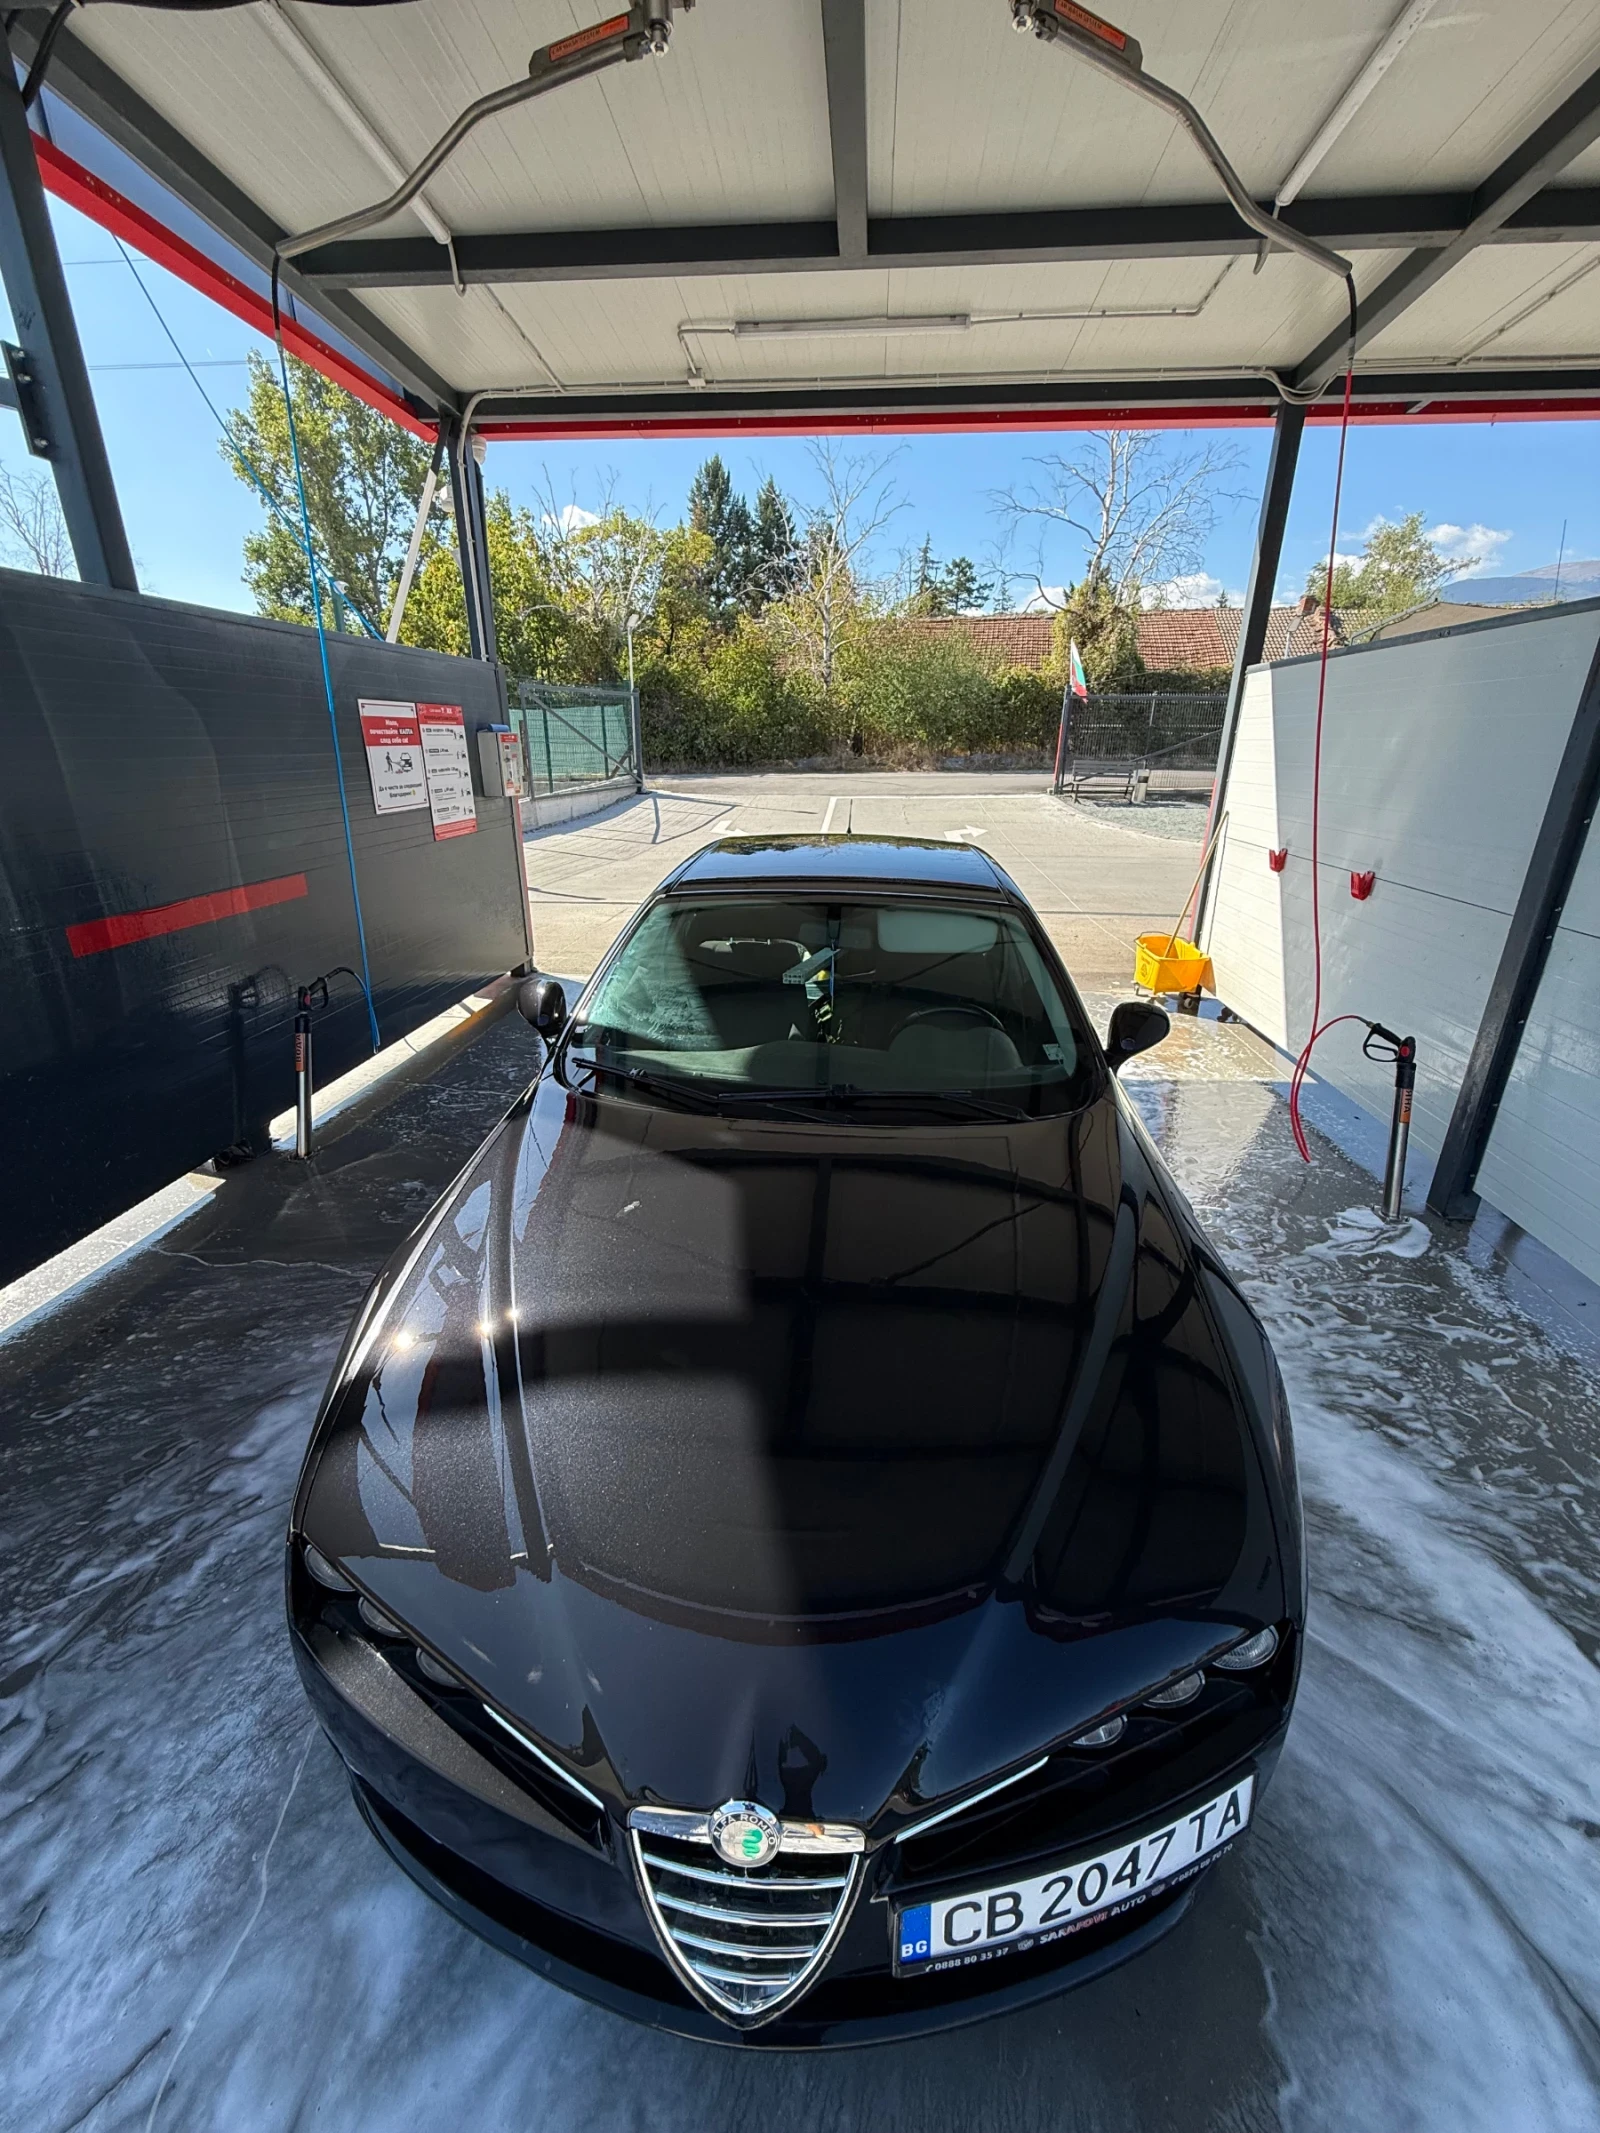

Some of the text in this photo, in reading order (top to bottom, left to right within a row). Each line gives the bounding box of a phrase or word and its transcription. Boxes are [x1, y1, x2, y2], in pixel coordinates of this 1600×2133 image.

[1403, 1089, 1412, 1112] ЯНА
[713, 1813, 776, 1845] ALFA ROMEO
[943, 1790, 1241, 1947] CB 2047 TA
[934, 1958, 962, 1971] 0888
[964, 1955, 978, 1965] 80
[980, 1951, 993, 1961] 35
[995, 1947, 1009, 1957] 37
[1111, 1894, 1147, 1916] AUTO
[901, 1940, 927, 1958] BG
